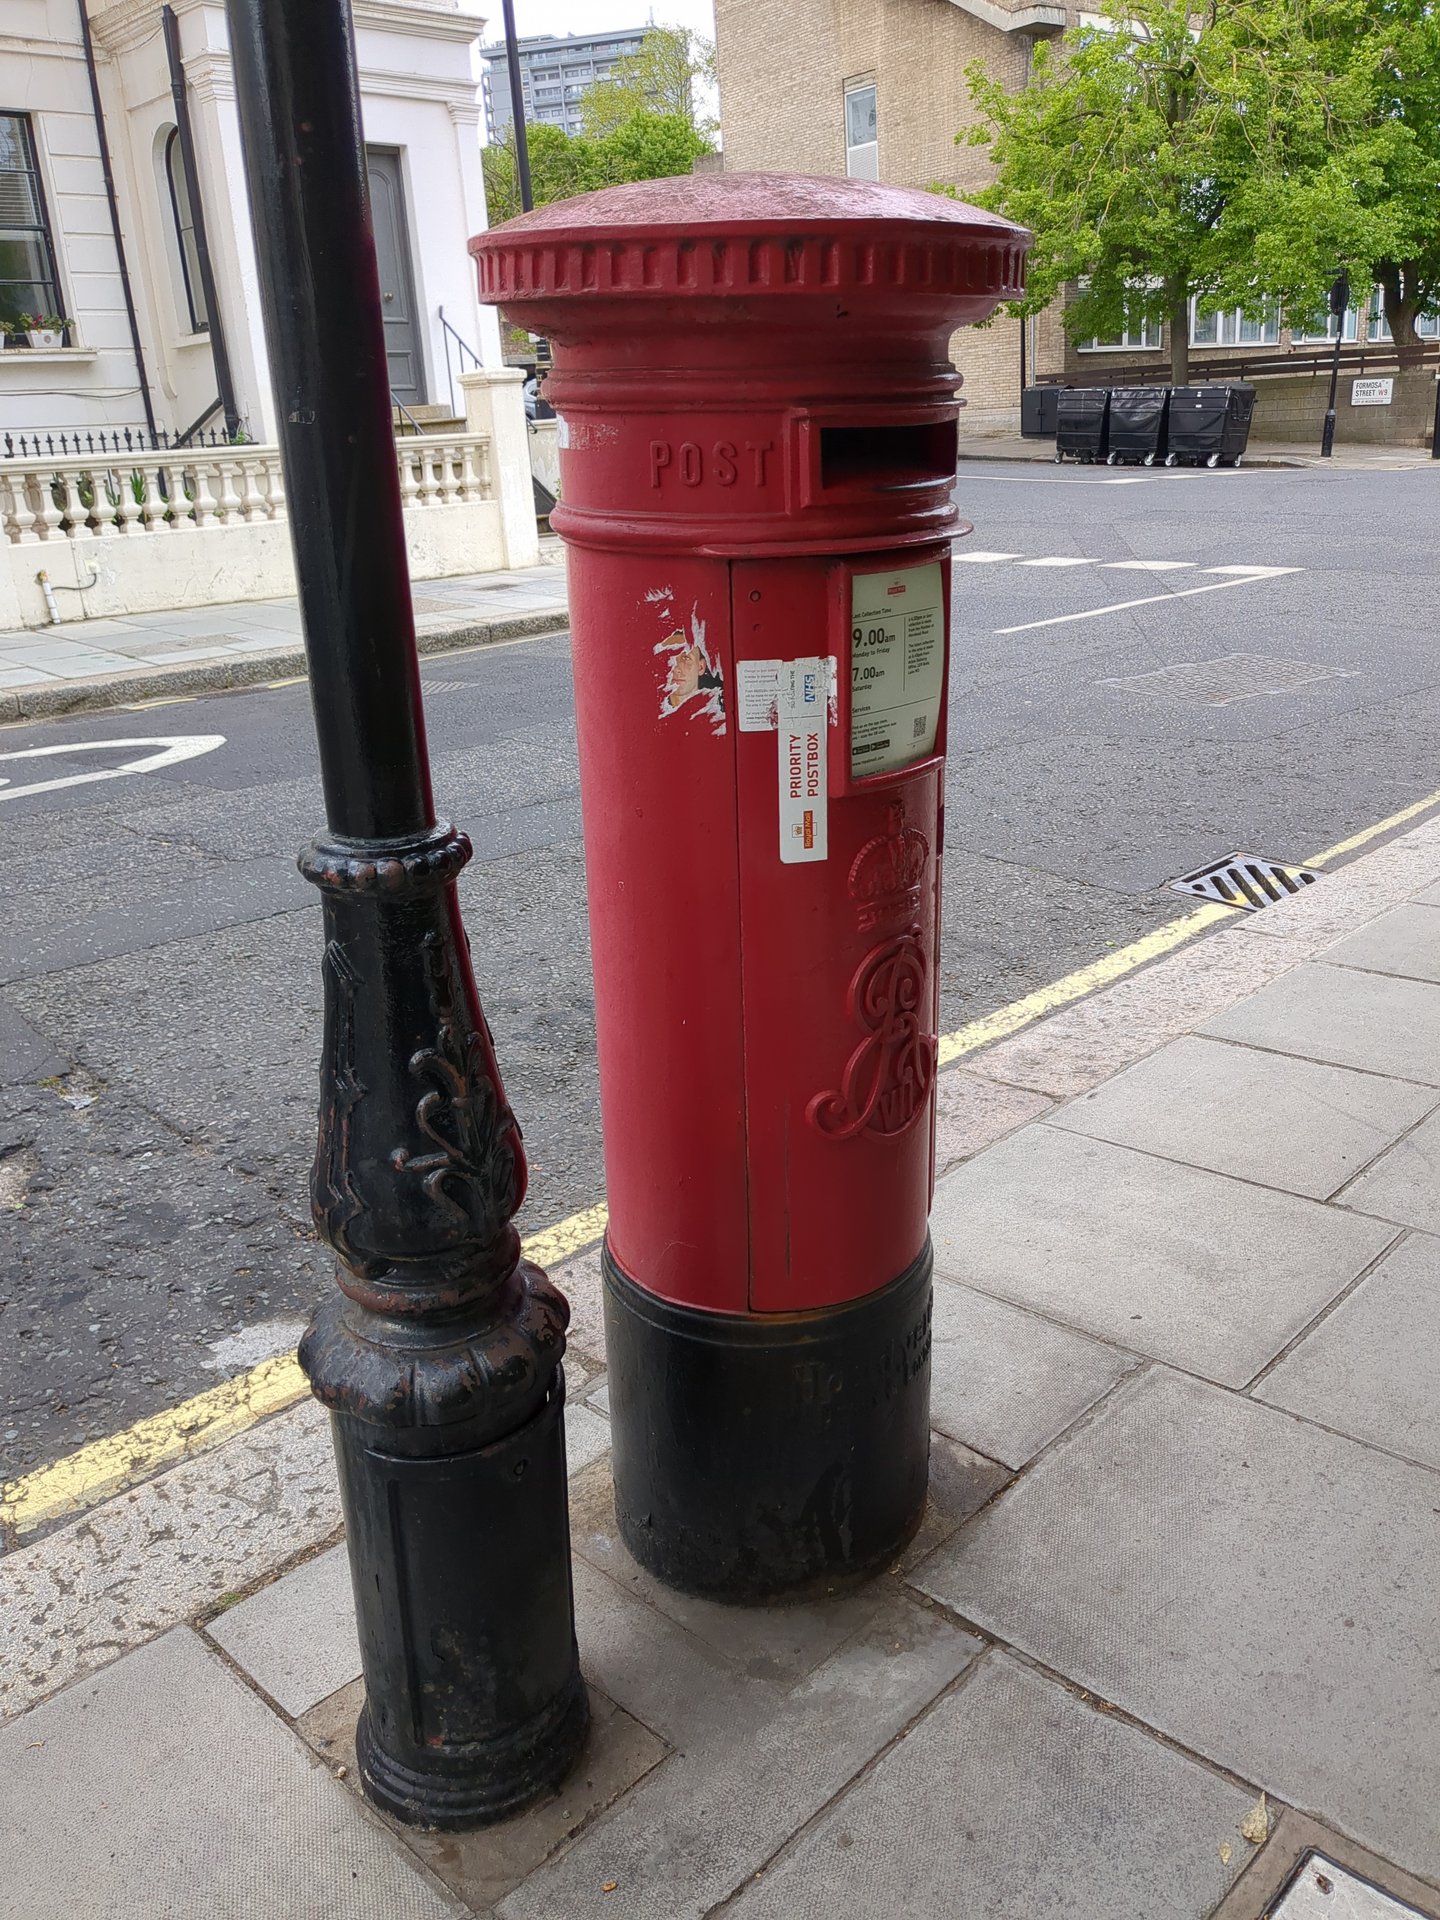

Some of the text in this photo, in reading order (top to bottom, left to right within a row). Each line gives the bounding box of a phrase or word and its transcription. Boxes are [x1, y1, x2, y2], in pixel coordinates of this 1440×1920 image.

[1355, 381, 1382, 389] FORMOSA
[1355, 389, 1376, 397] STREET
[649, 440, 774, 488] POST
[861, 608, 881, 618] Collection
[853, 628, 896, 649] 9.00am
[876, 647, 891, 655] Friday
[852, 666, 885, 682] 7.00am
[805, 675, 815, 702] NHS
[852, 683, 872, 692] Saturday
[789, 734, 802, 799] PRIORITY
[807, 732, 819, 797] POSTBOX
[804, 828, 813, 848] Royal
